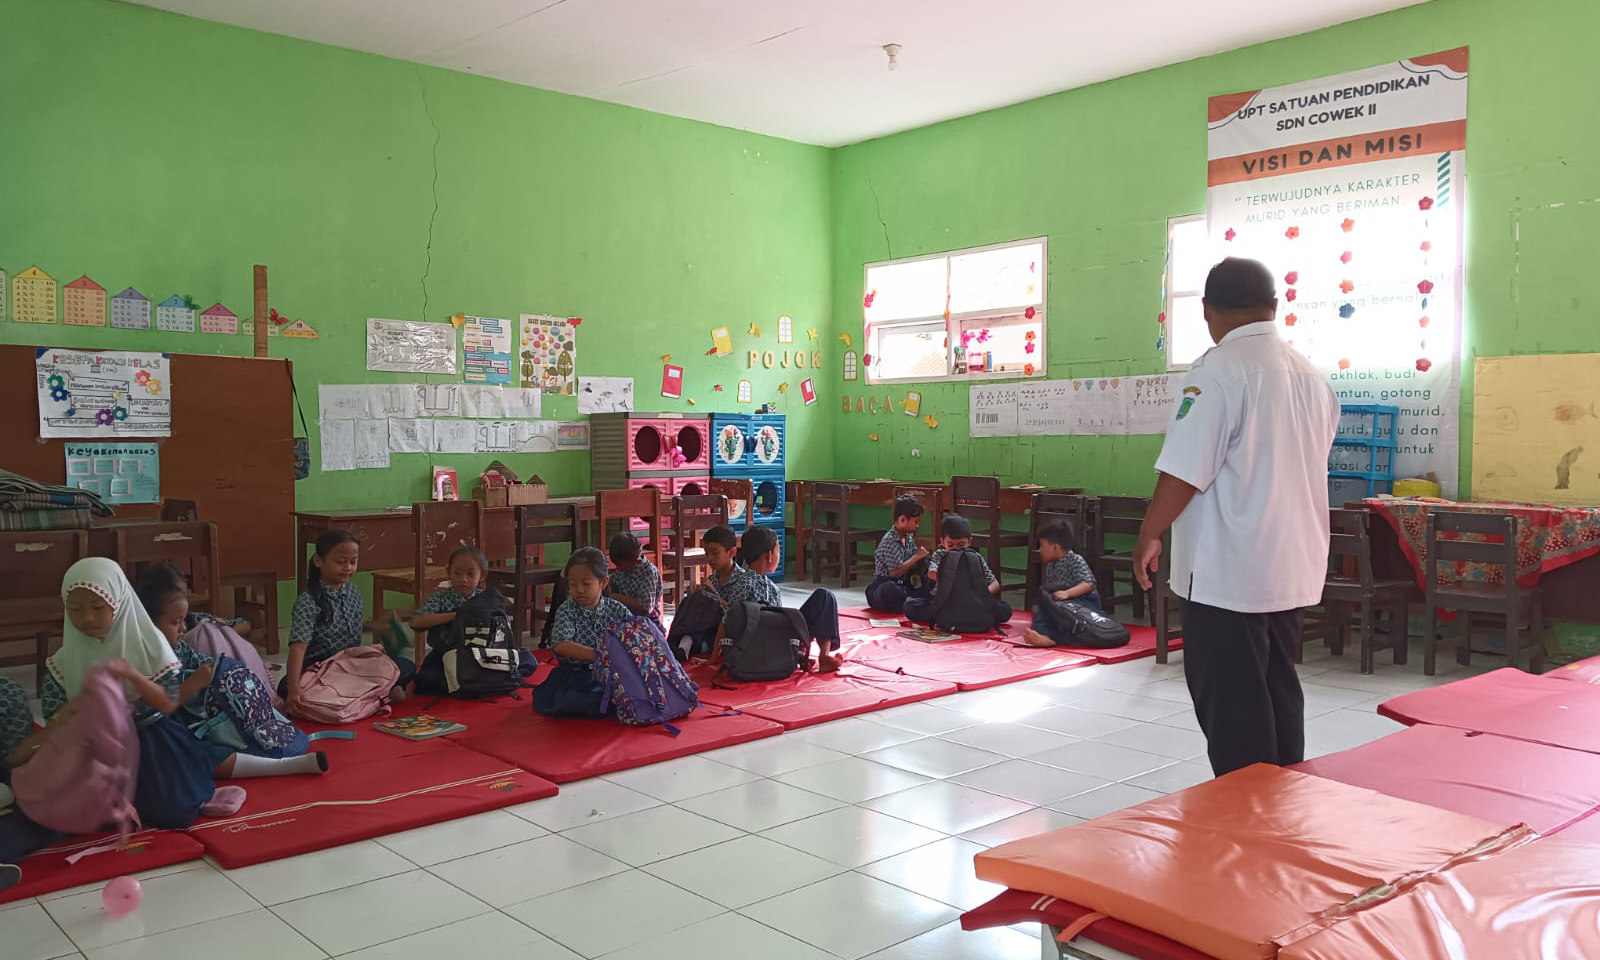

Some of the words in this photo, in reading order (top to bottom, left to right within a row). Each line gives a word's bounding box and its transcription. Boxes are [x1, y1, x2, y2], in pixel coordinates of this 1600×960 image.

[1238, 105, 1266, 120] UPT
[1269, 91, 1330, 114] SATUAN
[1333, 74, 1430, 100] PENDIDIKAN
[1276, 117, 1305, 131] SDN
[1308, 105, 1364, 126] COWEK
[1367, 103, 1377, 115] II
[1242, 153, 1288, 175] VISI
[1299, 143, 1353, 166] DAN
[1365, 133, 1423, 156] MISI
[1246, 184, 1342, 206] TERWUJUDNYA
[1347, 173, 1420, 191] KARAKTER
[1245, 208, 1285, 223] MURID
[1292, 204, 1331, 217] YANG
[748, 350, 822, 368] POJOK
[1330, 369, 1378, 380] akhlak,
[1384, 369, 1416, 379] budi
[1380, 388, 1431, 400] gotong
[841, 395, 894, 414] BACA
[1400, 406, 1445, 416] murid.
[1410, 424, 1438, 435] dan
[1396, 443, 1434, 454] untuk
